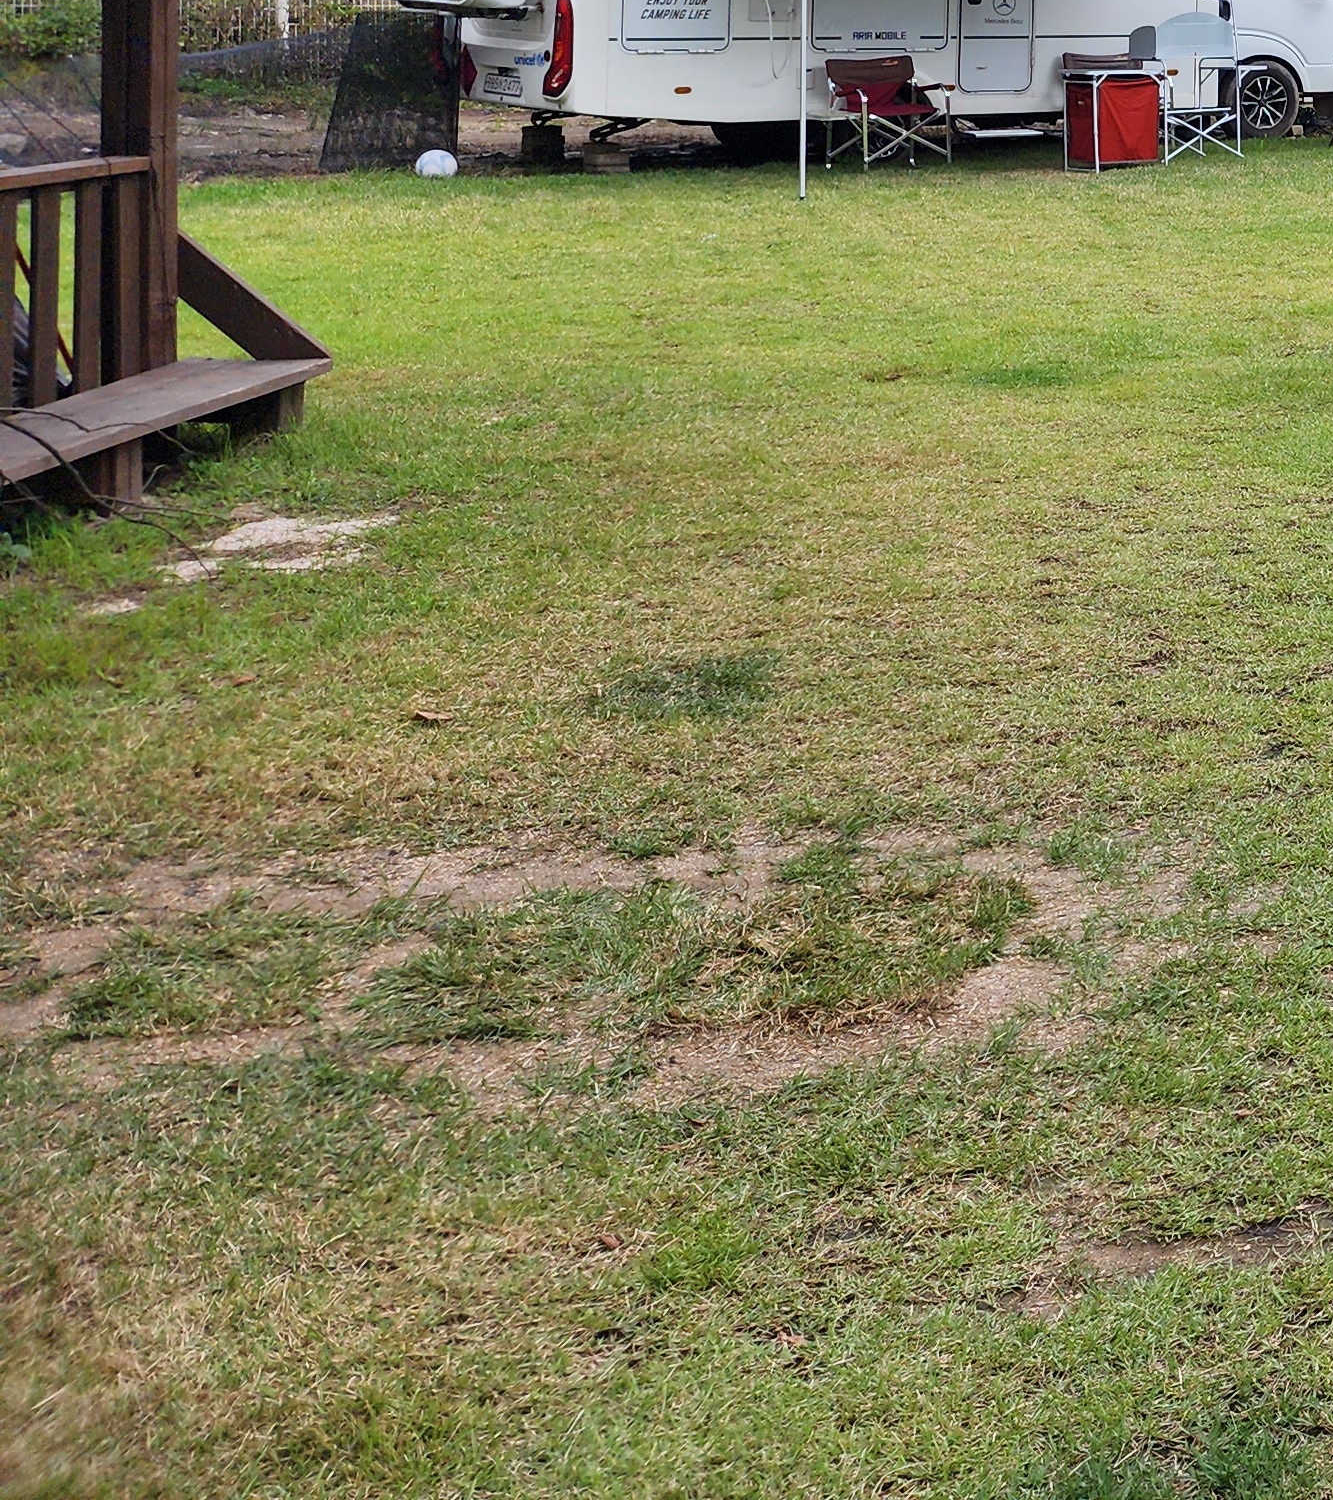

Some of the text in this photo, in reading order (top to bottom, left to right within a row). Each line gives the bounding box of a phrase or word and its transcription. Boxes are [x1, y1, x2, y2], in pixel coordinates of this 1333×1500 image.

[640, 8, 712, 20] CAMPING LIFE
[852, 31, 907, 41] ARIA MOBILE
[513, 52, 536, 66] unicef
